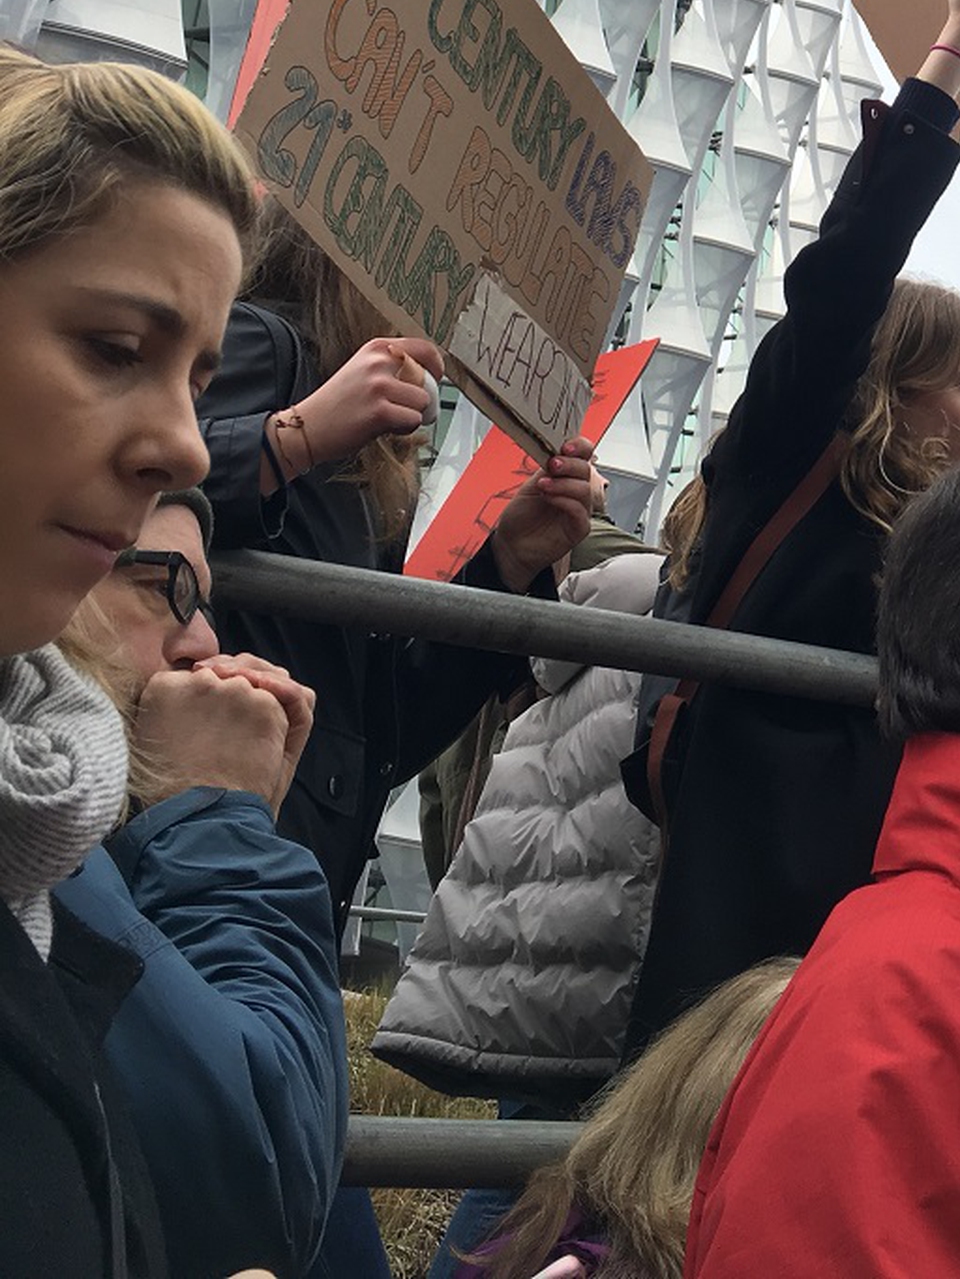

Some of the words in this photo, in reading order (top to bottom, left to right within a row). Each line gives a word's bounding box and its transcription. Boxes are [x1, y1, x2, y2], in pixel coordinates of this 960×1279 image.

[323, 135, 476, 346] CENTURY
[446, 125, 610, 362] REGULATE
[565, 131, 643, 269] LAWS
